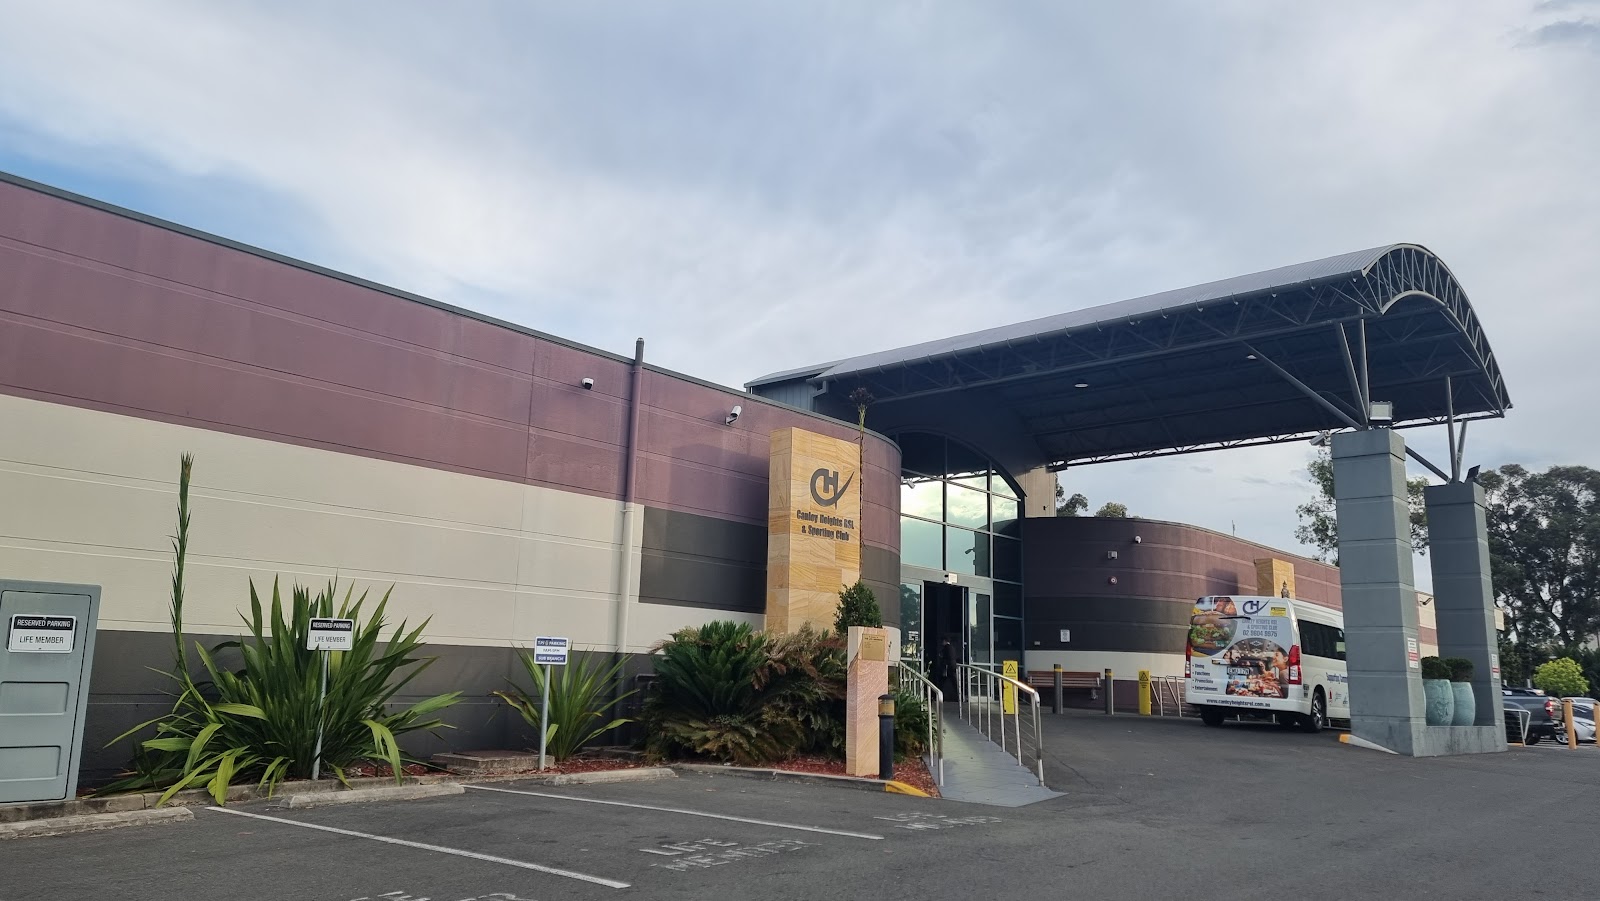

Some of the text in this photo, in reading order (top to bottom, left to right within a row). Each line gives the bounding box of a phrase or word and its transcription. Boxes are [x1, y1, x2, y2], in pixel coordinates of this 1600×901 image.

[797, 510, 854, 529] Canley Heights RSL
[808, 525, 834, 539] Sporting
[836, 530, 849, 541] Club
[17, 619, 46, 627] RESERVED
[35, 636, 64, 644] MEMBER
